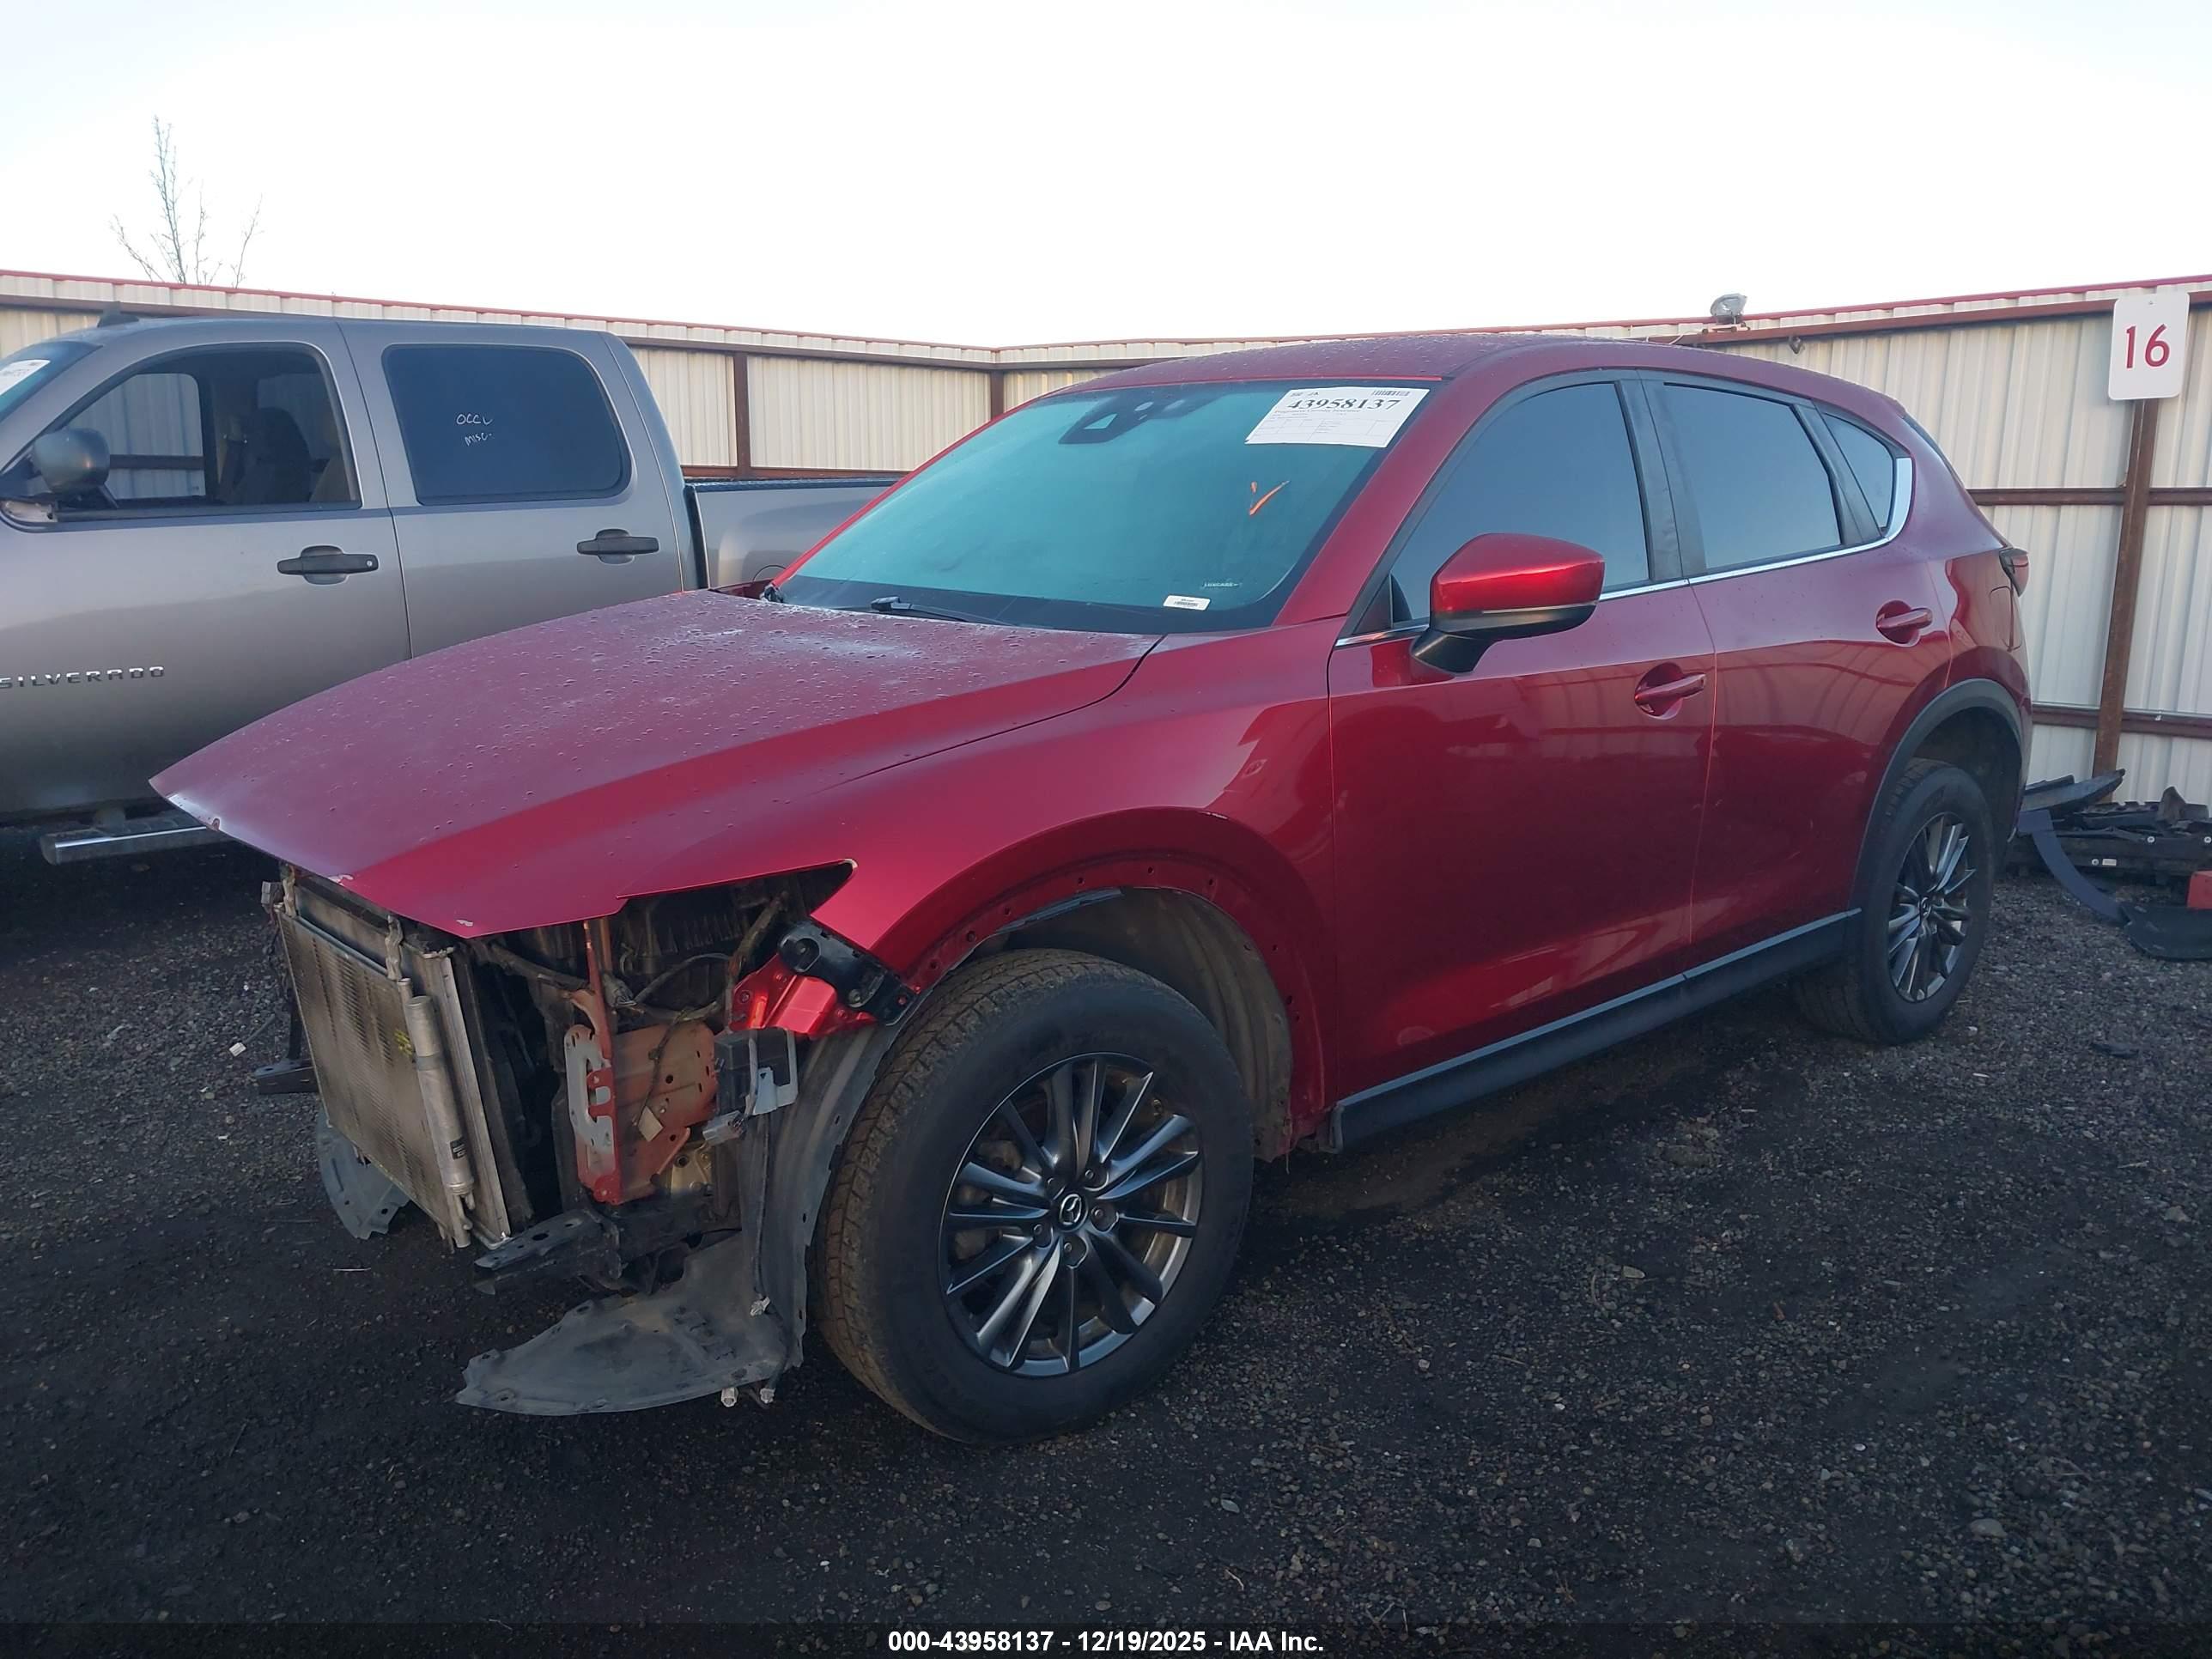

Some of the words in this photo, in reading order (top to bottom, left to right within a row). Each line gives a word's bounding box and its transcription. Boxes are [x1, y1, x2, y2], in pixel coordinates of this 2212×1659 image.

[2126, 324, 2170, 368] 16
[1287, 398, 1401, 410] 43958137
[0, 665, 165, 689] SILVERADO
